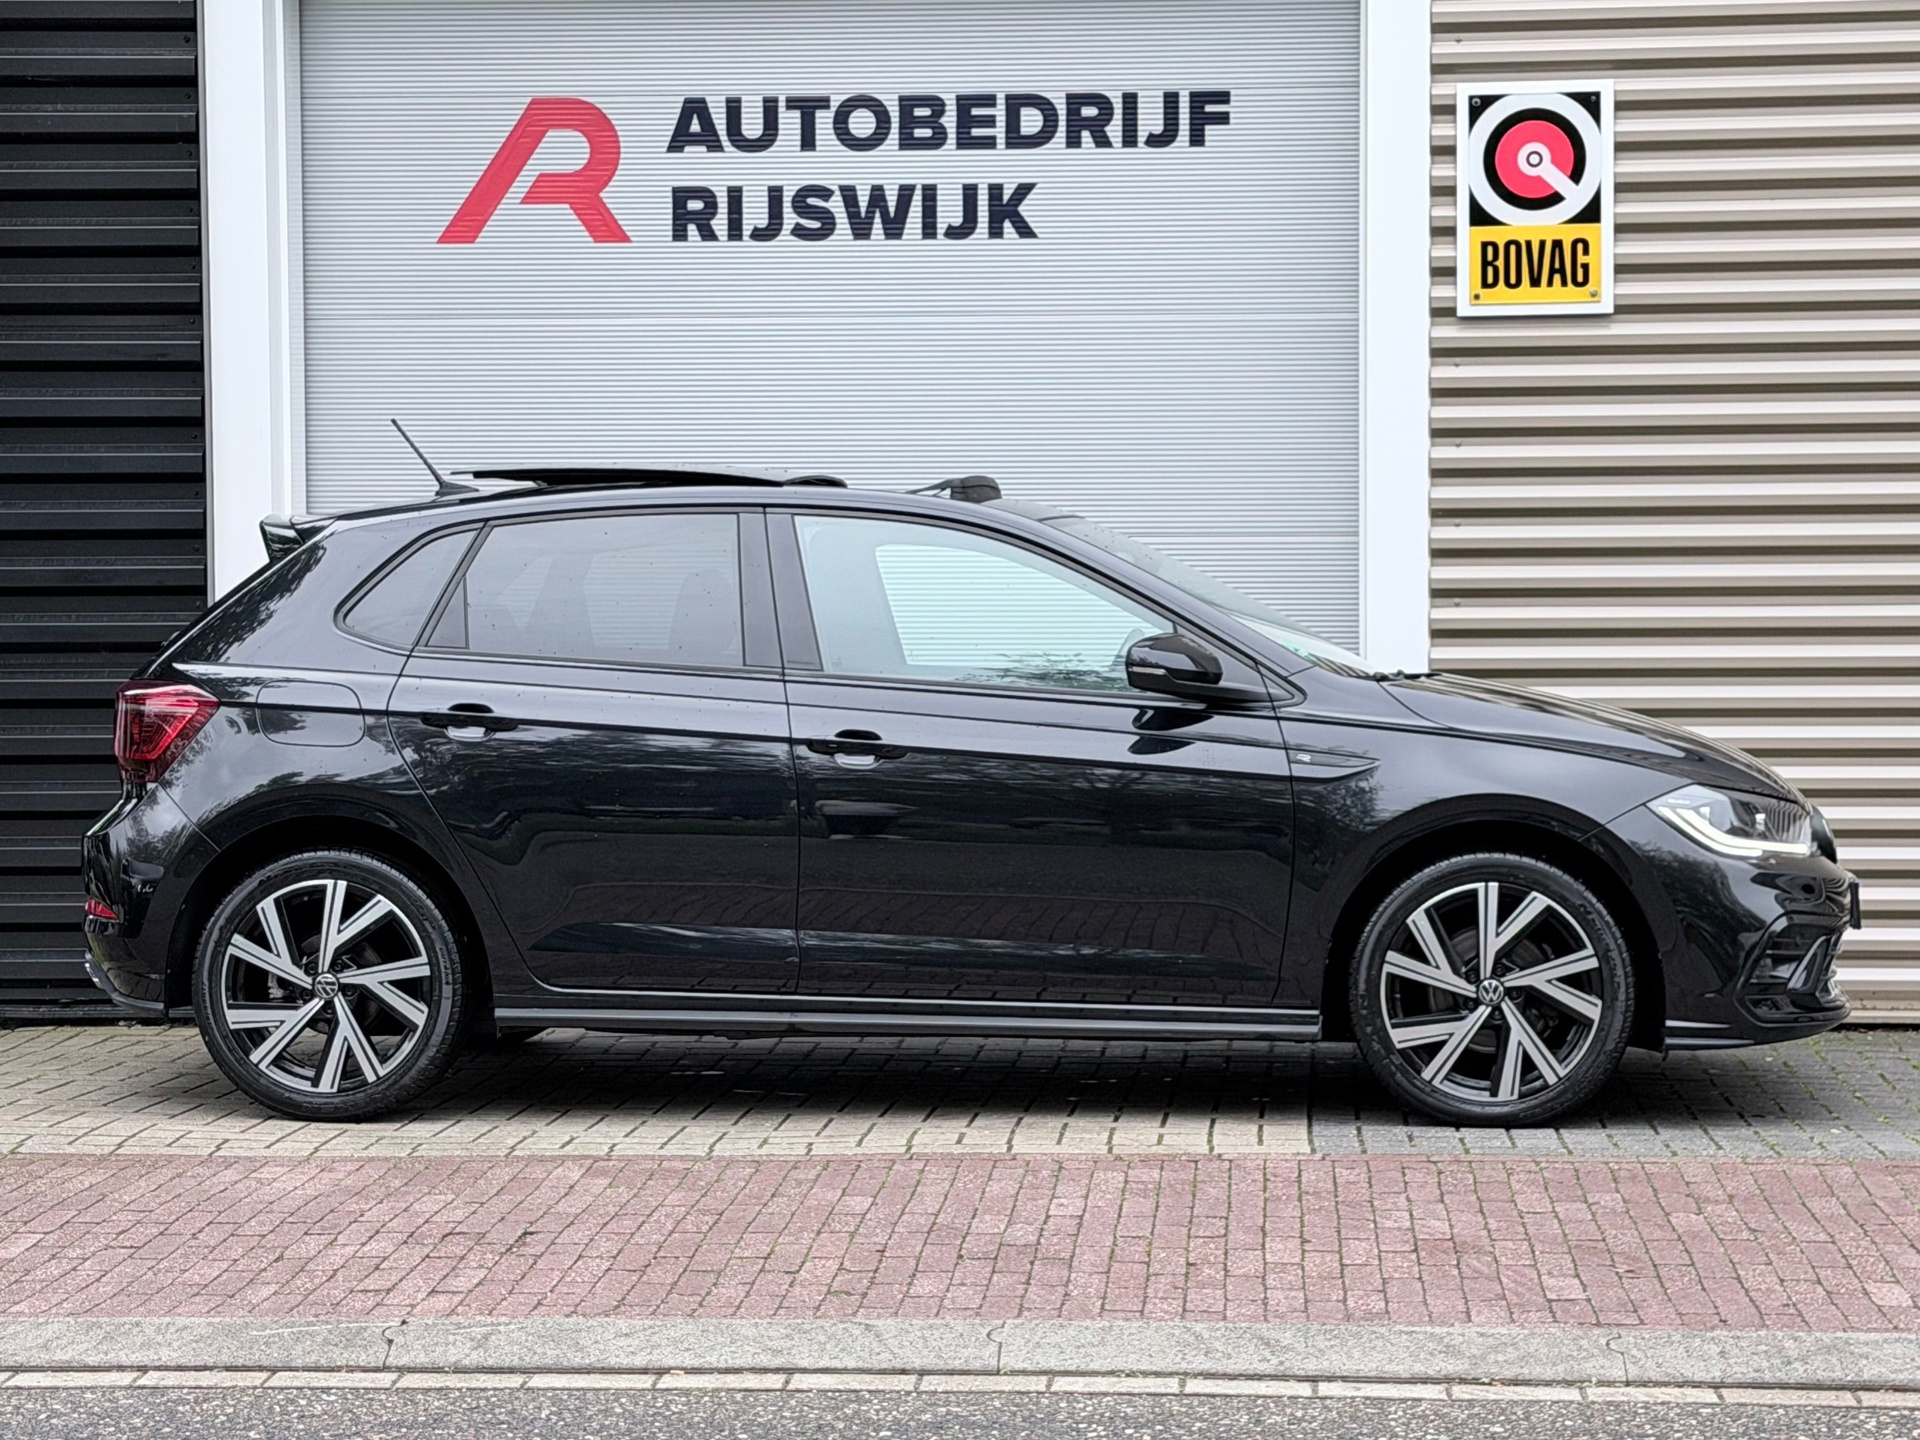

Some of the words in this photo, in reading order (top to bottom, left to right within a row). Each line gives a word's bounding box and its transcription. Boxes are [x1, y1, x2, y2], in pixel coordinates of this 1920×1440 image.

[666, 91, 1231, 154] AUTOBEDRIJF
[672, 183, 1039, 242] RIJSWIJK
[1481, 237, 1590, 289] BOVAG
